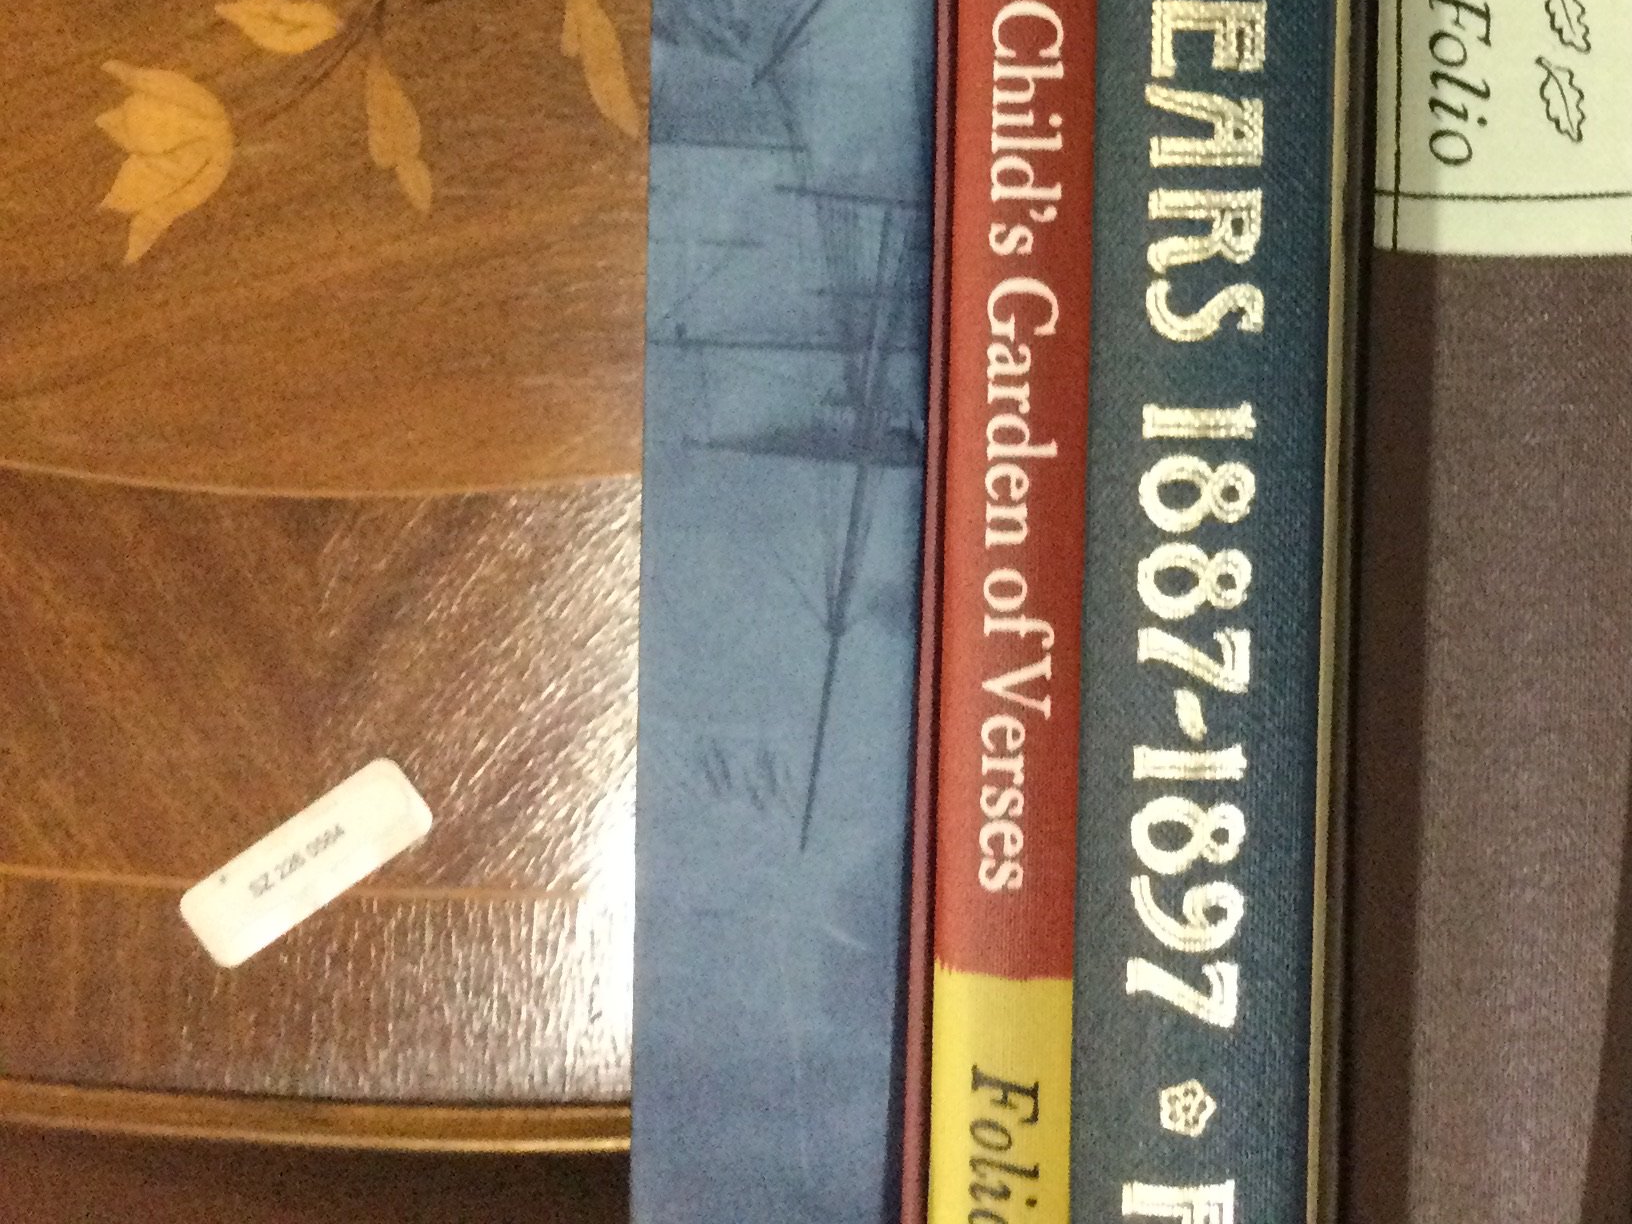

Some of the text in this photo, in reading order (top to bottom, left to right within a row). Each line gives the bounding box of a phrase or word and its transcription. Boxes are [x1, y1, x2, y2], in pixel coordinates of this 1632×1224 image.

[990, 0, 1065, 257] Child's
[984, 277, 1060, 548] Garden
[982, 567, 1055, 654] of
[1126, 402, 1256, 1029] 1887-1897
[977, 654, 1054, 893] Verses
